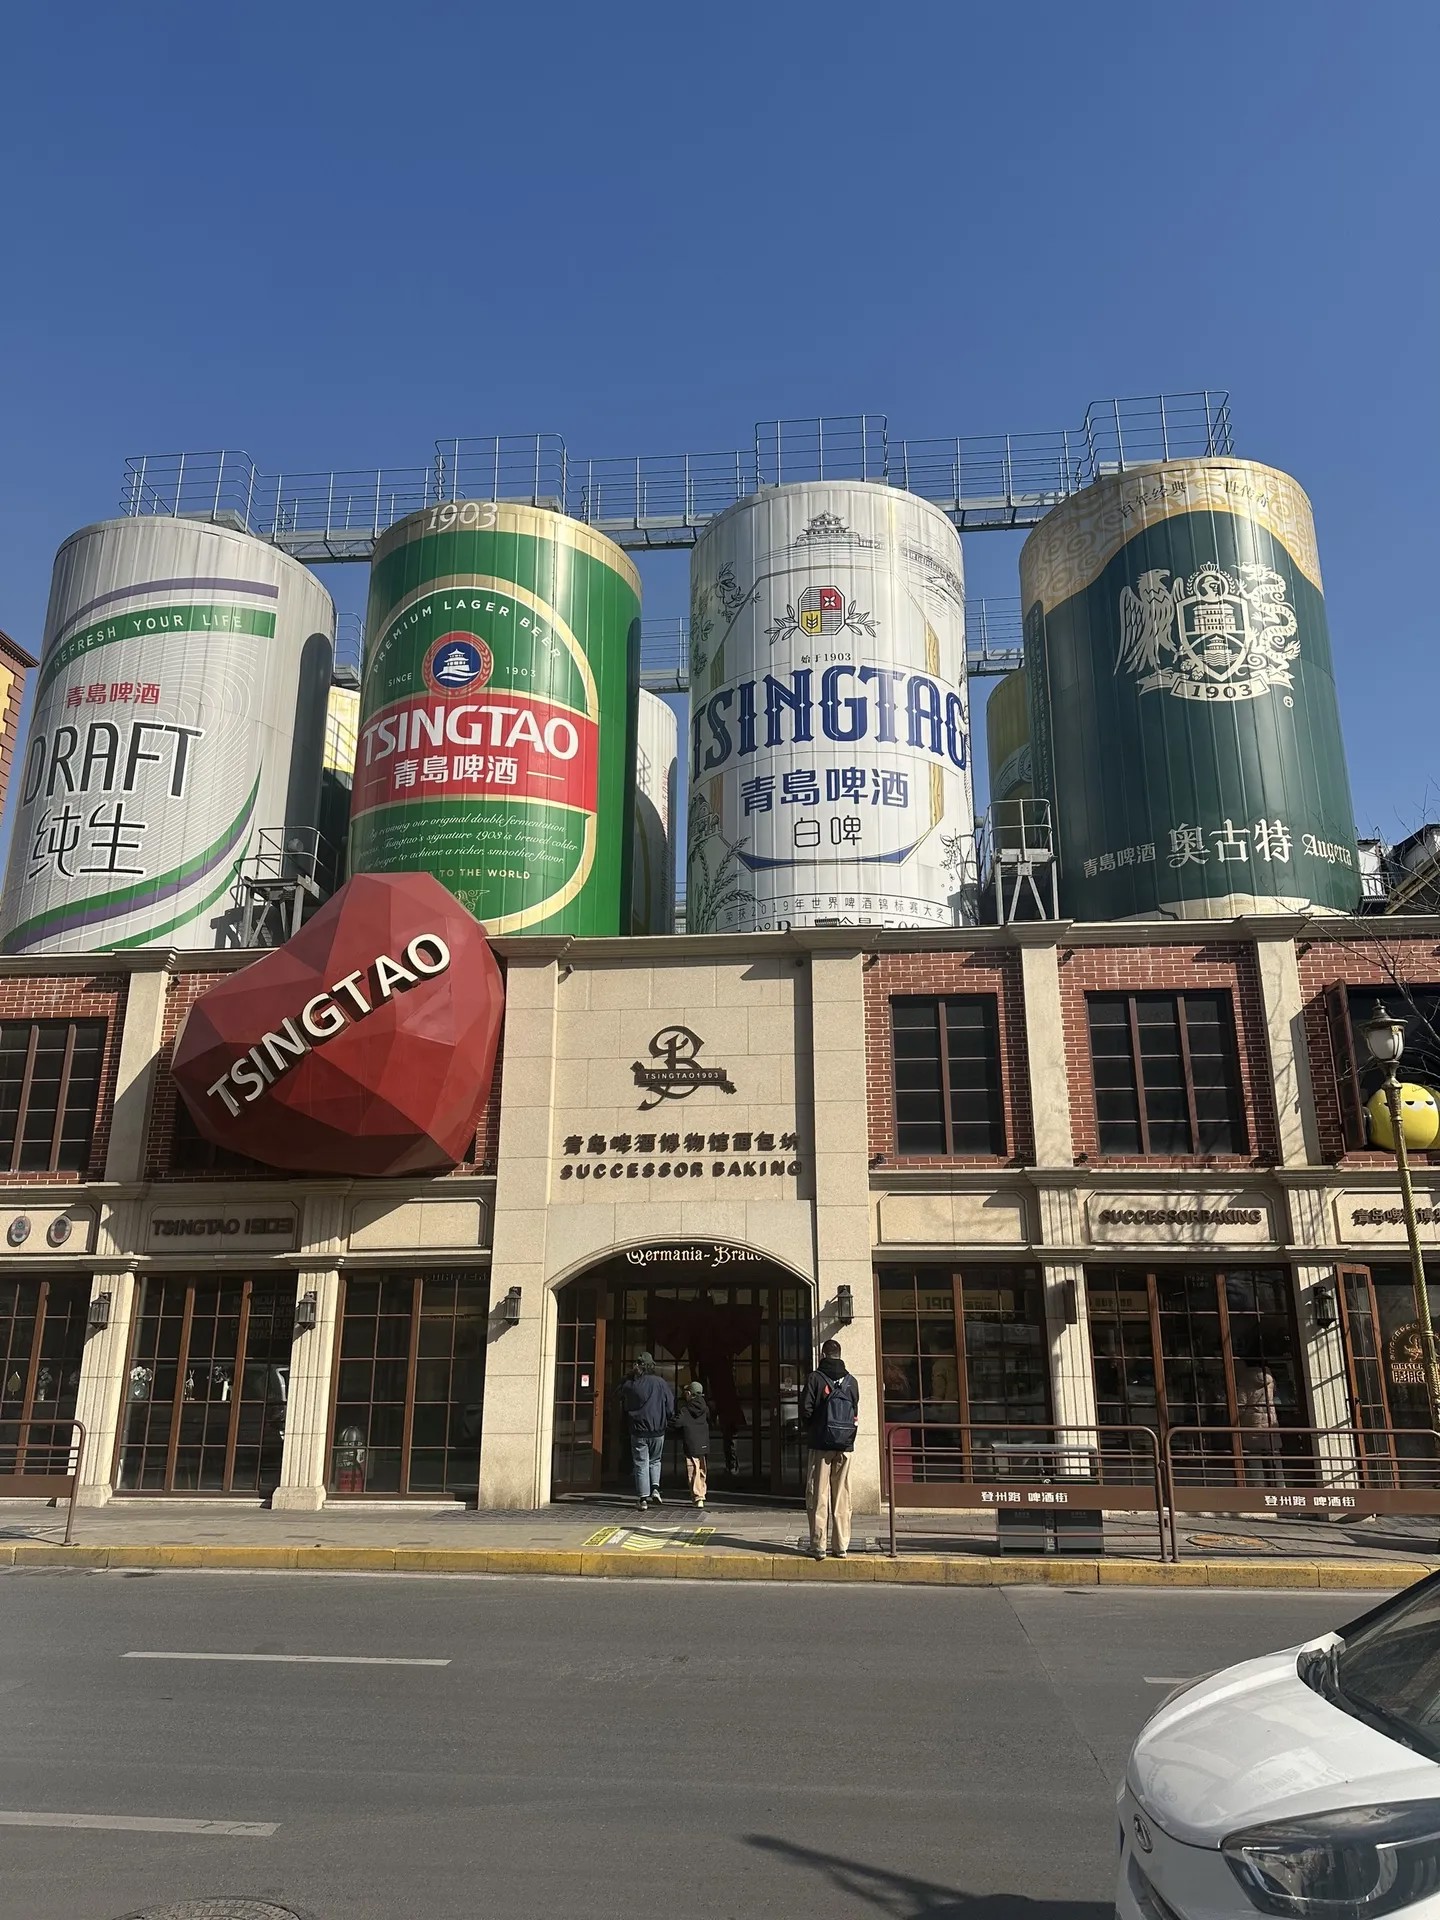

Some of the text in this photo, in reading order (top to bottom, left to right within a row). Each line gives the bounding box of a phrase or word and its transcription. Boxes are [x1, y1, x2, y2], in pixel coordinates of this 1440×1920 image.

[1118, 480, 1187, 519] 百年经典
[425, 501, 498, 532] 1903
[53, 614, 243, 669] REFRESH YOUR LIFE
[373, 599, 561, 673] PREMIUM LAGER BEER
[388, 672, 412, 687] SINCE
[505, 666, 537, 678] 1903
[65, 682, 161, 710] 青島啤酒
[1191, 684, 1253, 699] 1903
[362, 703, 580, 768] TSINGTAO
[24, 721, 203, 806] DRAFT
[393, 754, 518, 790] 青島啤酒
[740, 767, 909, 816] 青島啤酒
[412, 819, 428, 827] our
[430, 813, 471, 827] original
[470, 813, 505, 824] double
[500, 815, 566, 832] fermentation
[794, 815, 862, 848] 白啤
[28, 802, 146, 878] 纯生
[398, 853, 407, 861] to
[409, 847, 443, 859] achieve
[488, 848, 534, 859] smoother
[427, 831, 473, 844] signature
[475, 830, 502, 841] 1903
[503, 831, 511, 840] is
[515, 831, 551, 845] brewed
[551, 838, 578, 851] colder
[1083, 818, 1293, 879] 青島啤酒 奥古特
[1301, 833, 1354, 865] Augerta
[440, 868, 531, 880] TO THE WORLD
[206, 933, 451, 1118] TSINGTAO
[563, 1131, 801, 1156] 青岛啤酒博物馆面包坊
[560, 1160, 803, 1181] SUCCESSOR BAKING
[152, 1218, 241, 1236] TSINGTAO
[1351, 1208, 1440, 1226] 青岛啤博
[981, 1491, 1068, 1503] 登州路 啤酒街
[1264, 1495, 1356, 1507] 登州路 啤酒街
